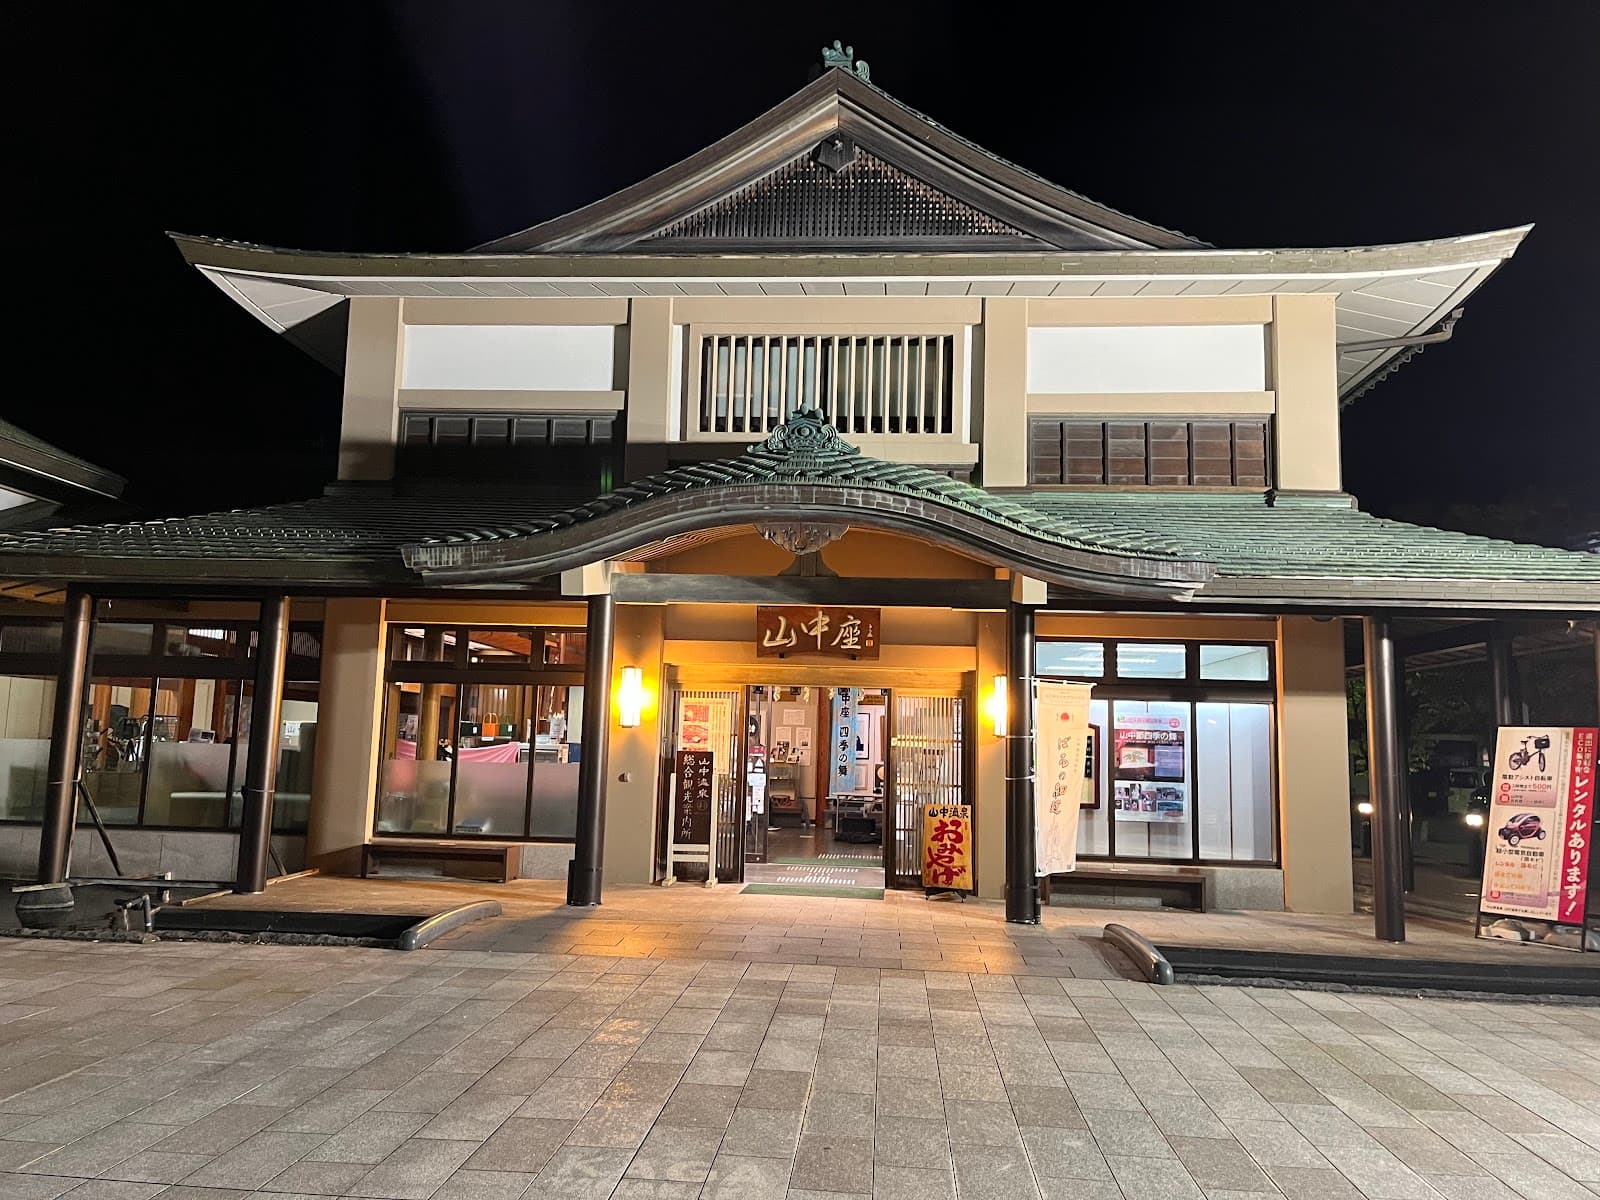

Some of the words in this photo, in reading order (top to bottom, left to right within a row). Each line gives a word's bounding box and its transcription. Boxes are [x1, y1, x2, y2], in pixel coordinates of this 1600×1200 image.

[763, 611, 861, 650] 山中座
[839, 689, 851, 718] 中座
[837, 726, 849, 777] 四季の舞
[681, 753, 696, 841] 総合観光案内所
[1502, 774, 1553, 782] 電動アシスト自転車
[928, 806, 969, 819] 山中温泉
[926, 819, 967, 886] おみやげ
[1564, 775, 1590, 917] レンタルあります！
